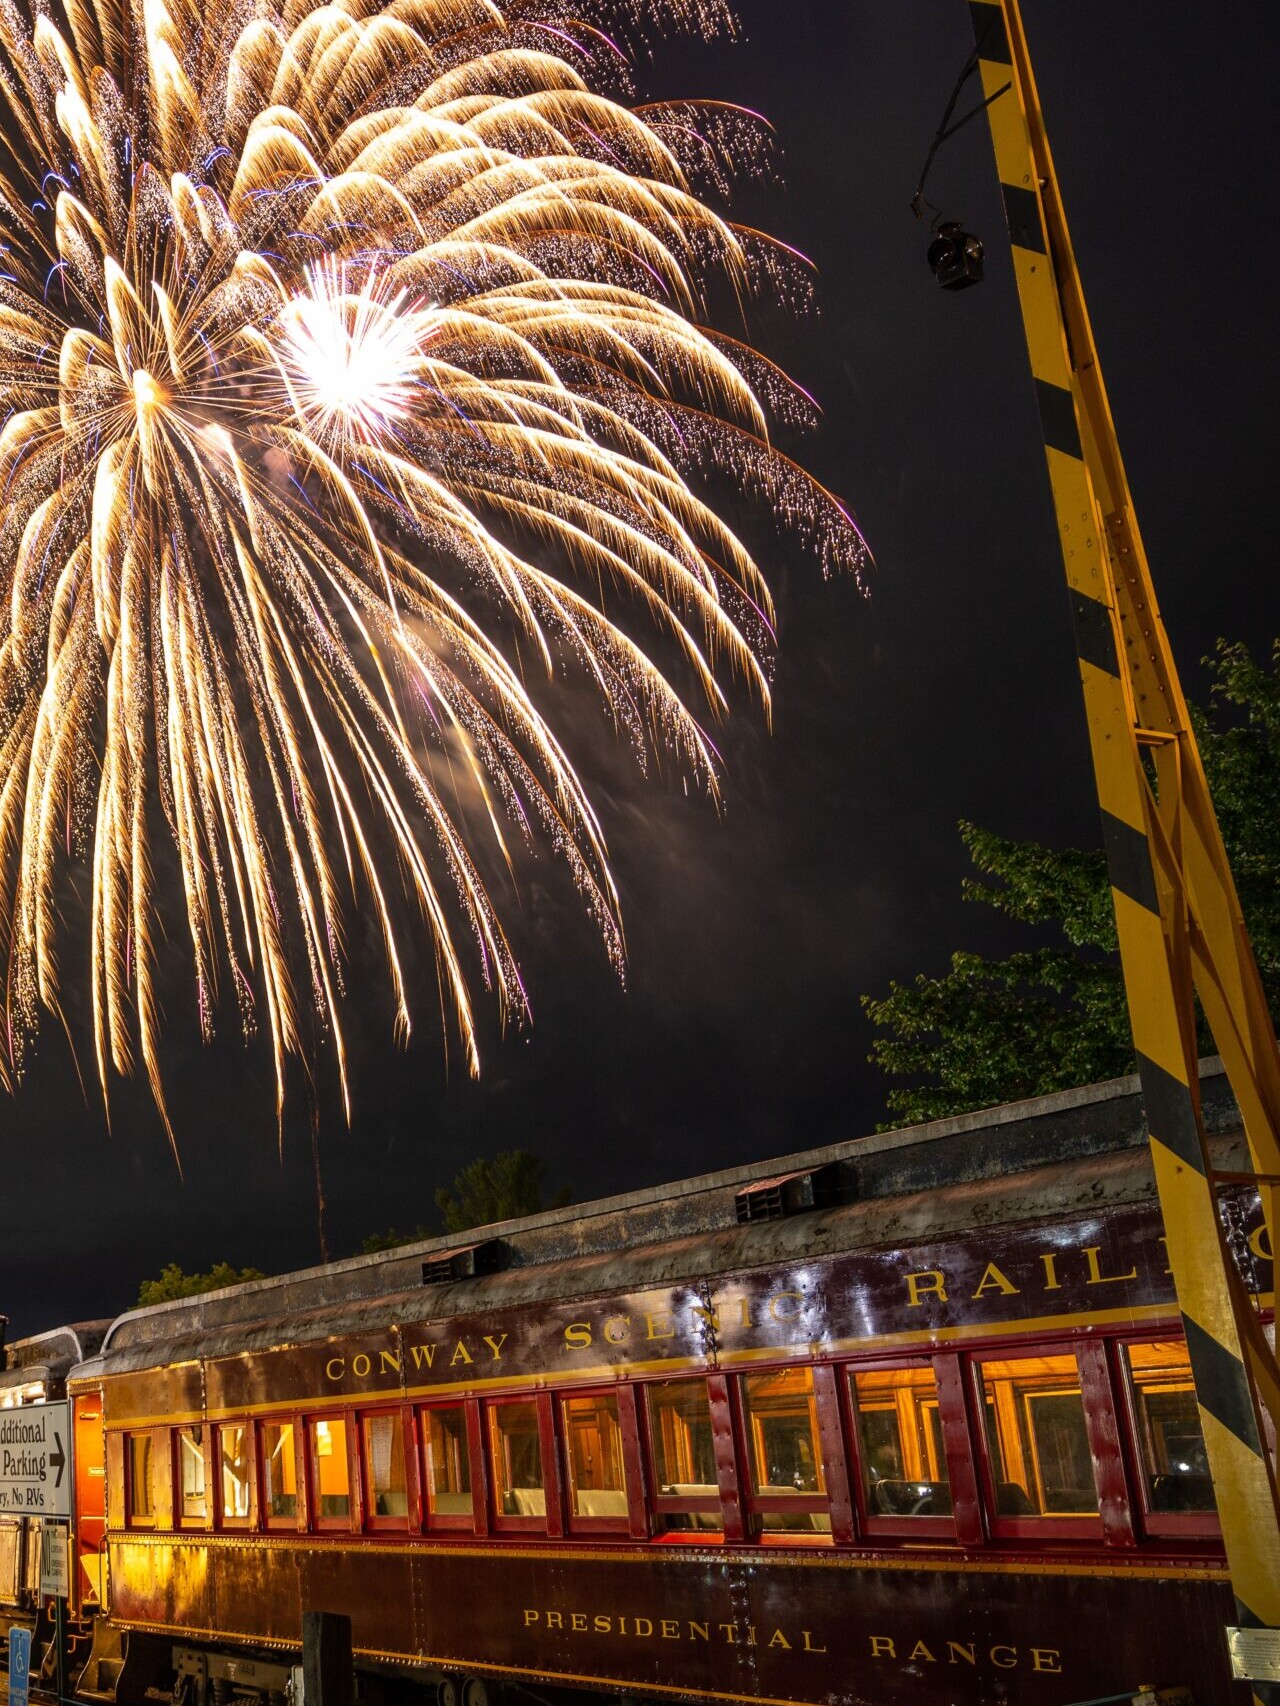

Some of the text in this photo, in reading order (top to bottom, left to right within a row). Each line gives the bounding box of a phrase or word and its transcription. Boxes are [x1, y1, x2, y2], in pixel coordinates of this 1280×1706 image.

[326, 1333, 508, 1380] CONWAY
[564, 1292, 803, 1351] SCENIC
[3, 1449, 47, 1481] Parking
[12, 1487, 23, 1505] No
[26, 1487, 45, 1506] RVs
[42, 1529, 50, 1576] NO
[523, 1609, 1062, 1673] PRESIDENTIAL RANGE
